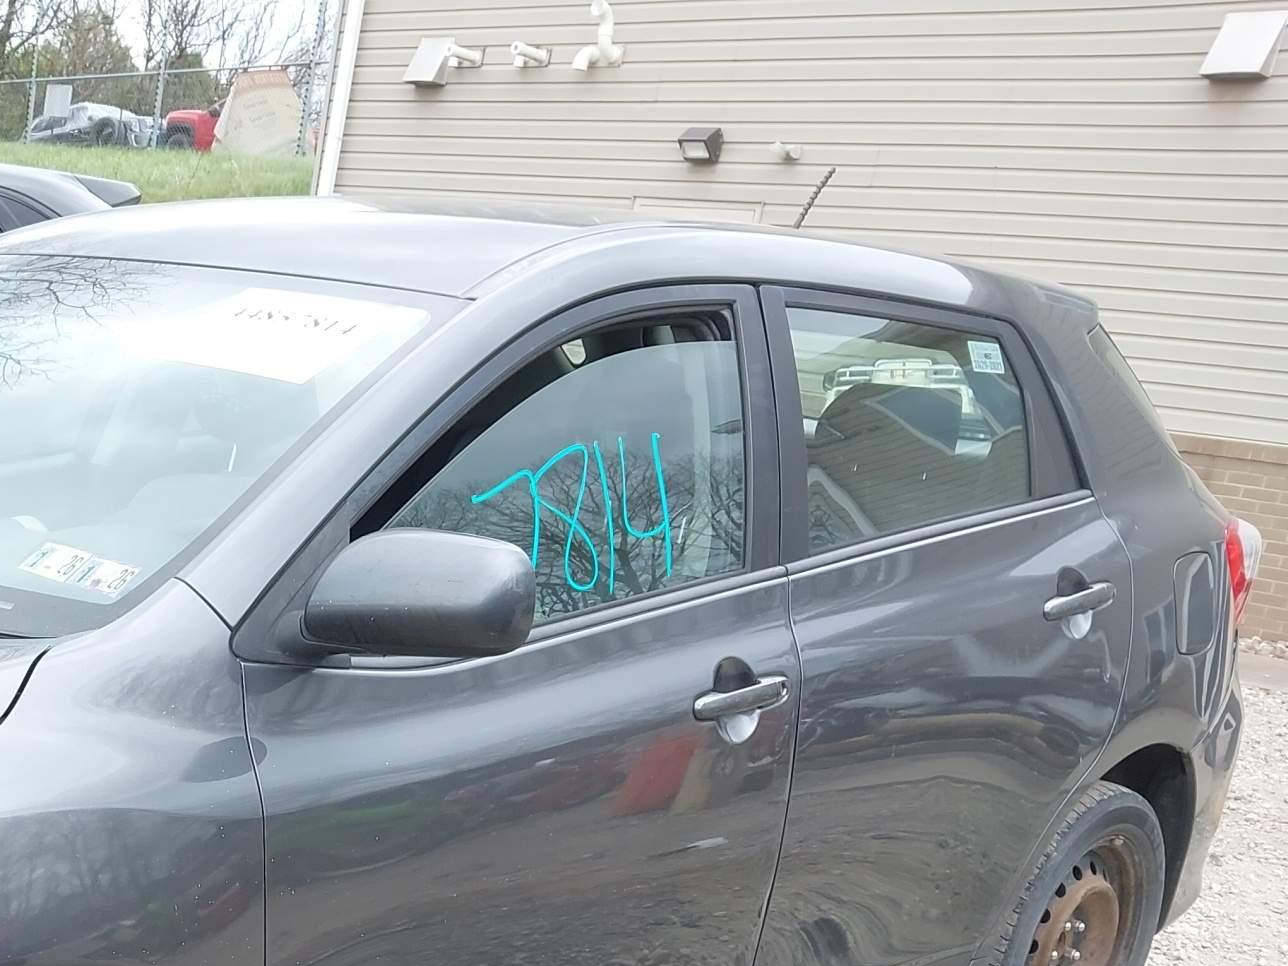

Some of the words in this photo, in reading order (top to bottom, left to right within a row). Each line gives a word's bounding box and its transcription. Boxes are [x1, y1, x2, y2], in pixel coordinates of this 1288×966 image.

[471, 431, 673, 594] 7814
[56, 554, 86, 576] 26
[107, 568, 136, 590] 26
